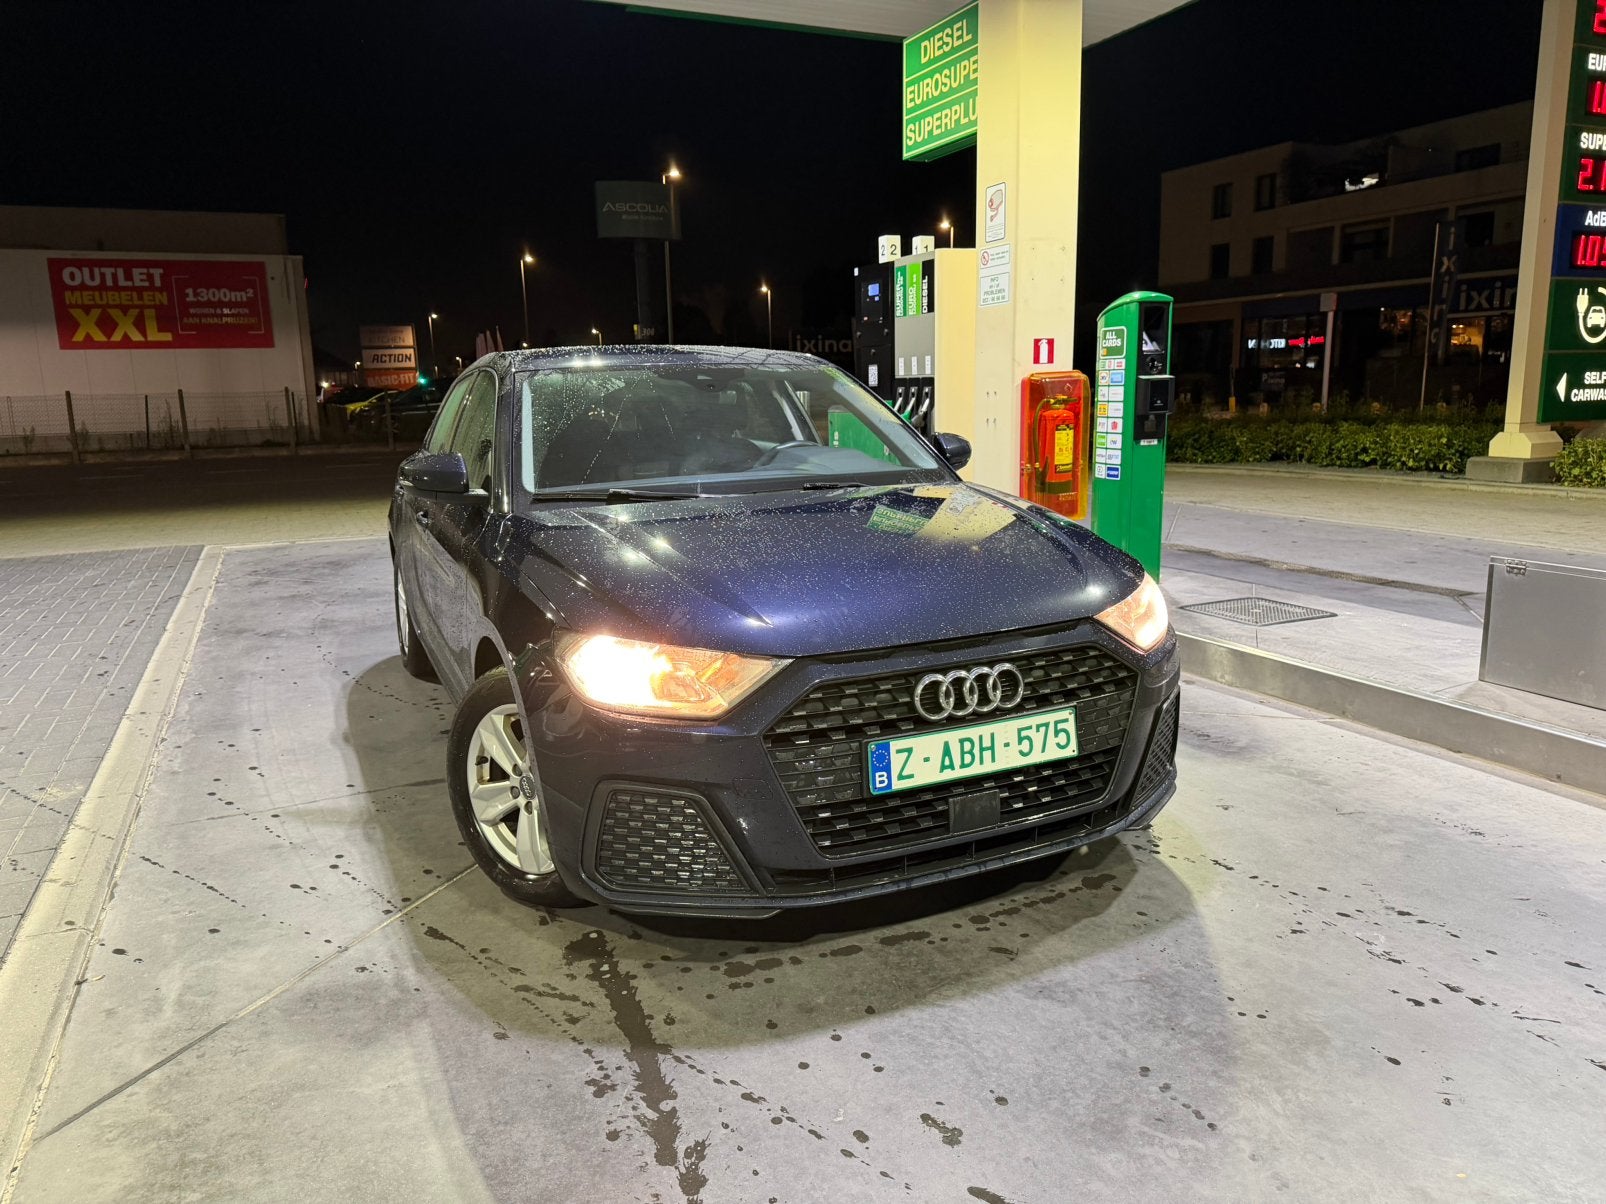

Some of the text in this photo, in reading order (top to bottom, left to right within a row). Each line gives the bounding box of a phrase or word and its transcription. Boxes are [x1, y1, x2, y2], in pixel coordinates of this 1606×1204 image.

[920, 19, 972, 64] DIESEL
[602, 202, 668, 213] ASCOLIA
[890, 244, 897, 255] 2
[62, 266, 164, 287] OUTLET
[64, 291, 168, 305] MEUBELEN
[69, 308, 173, 341] XXL
[1103, 338, 1121, 347] CARDS
[1106, 331, 1117, 339] ALL
[795, 335, 853, 353] ixina
[372, 353, 412, 363] ACTION
[895, 717, 1071, 782] Z-ABH-575
[875, 771, 889, 788] B
